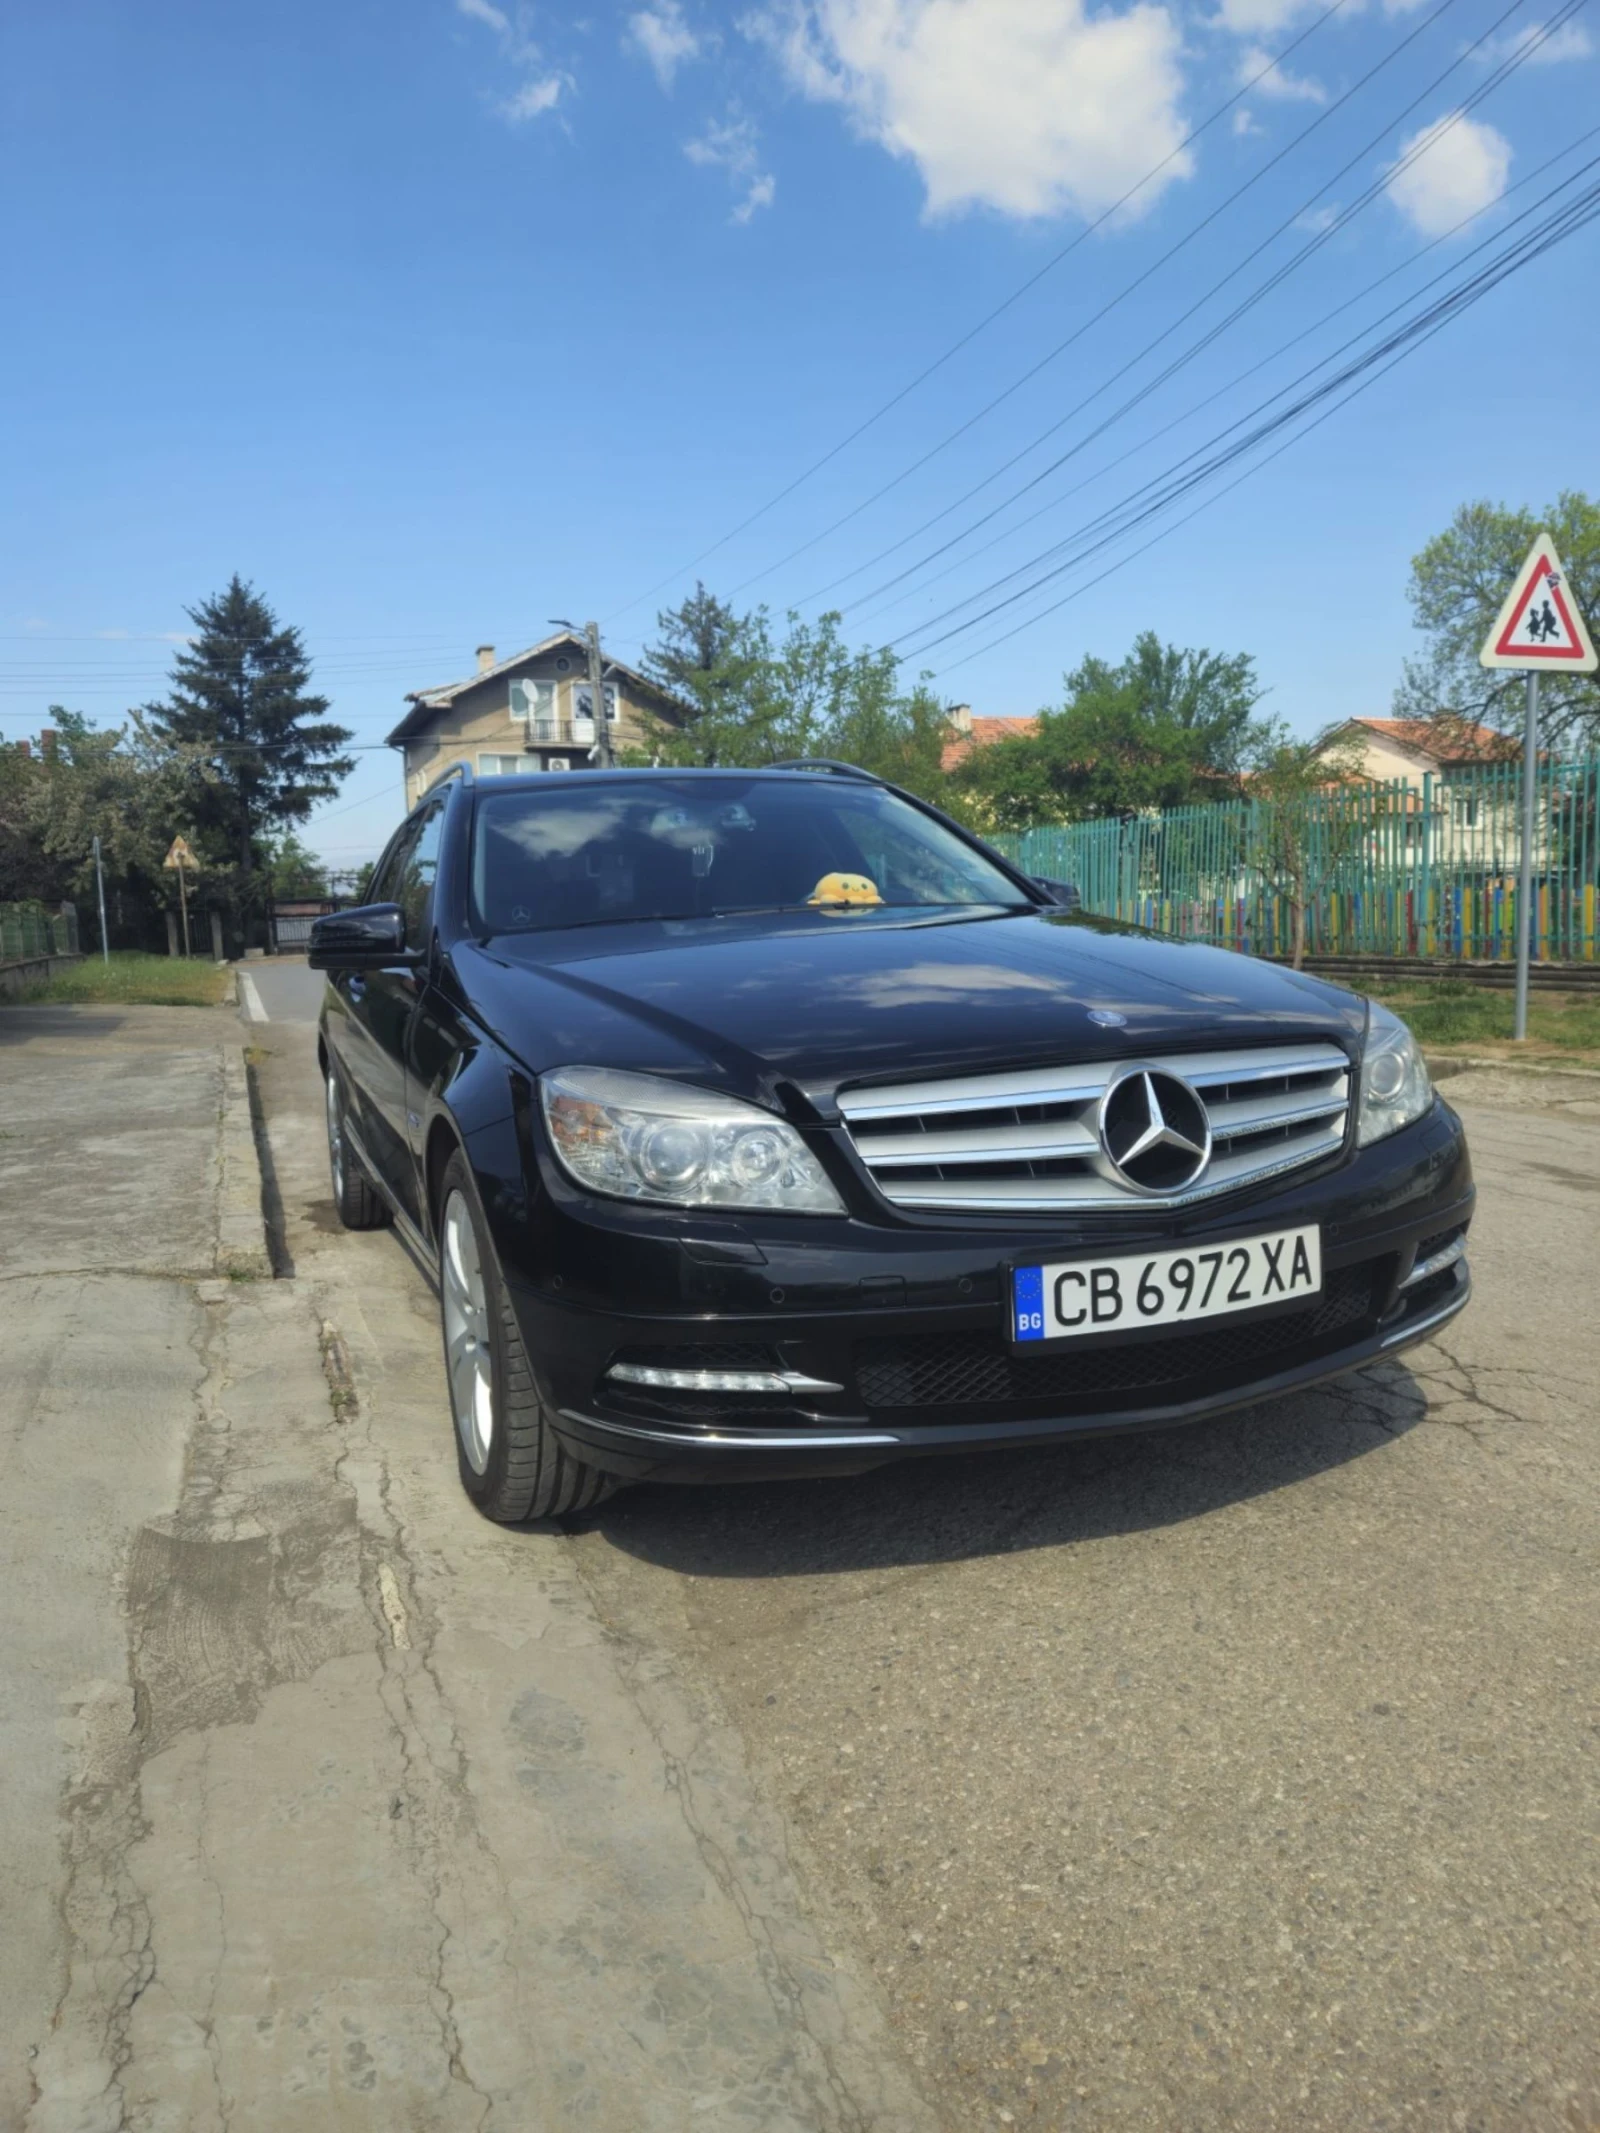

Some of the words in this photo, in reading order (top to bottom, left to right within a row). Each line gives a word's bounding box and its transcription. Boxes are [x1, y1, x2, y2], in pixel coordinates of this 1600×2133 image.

[1053, 1267, 1123, 1326] CB
[1136, 1248, 1251, 1316] 6972
[1261, 1235, 1313, 1297] XA
[1018, 1312, 1042, 1332] BG
